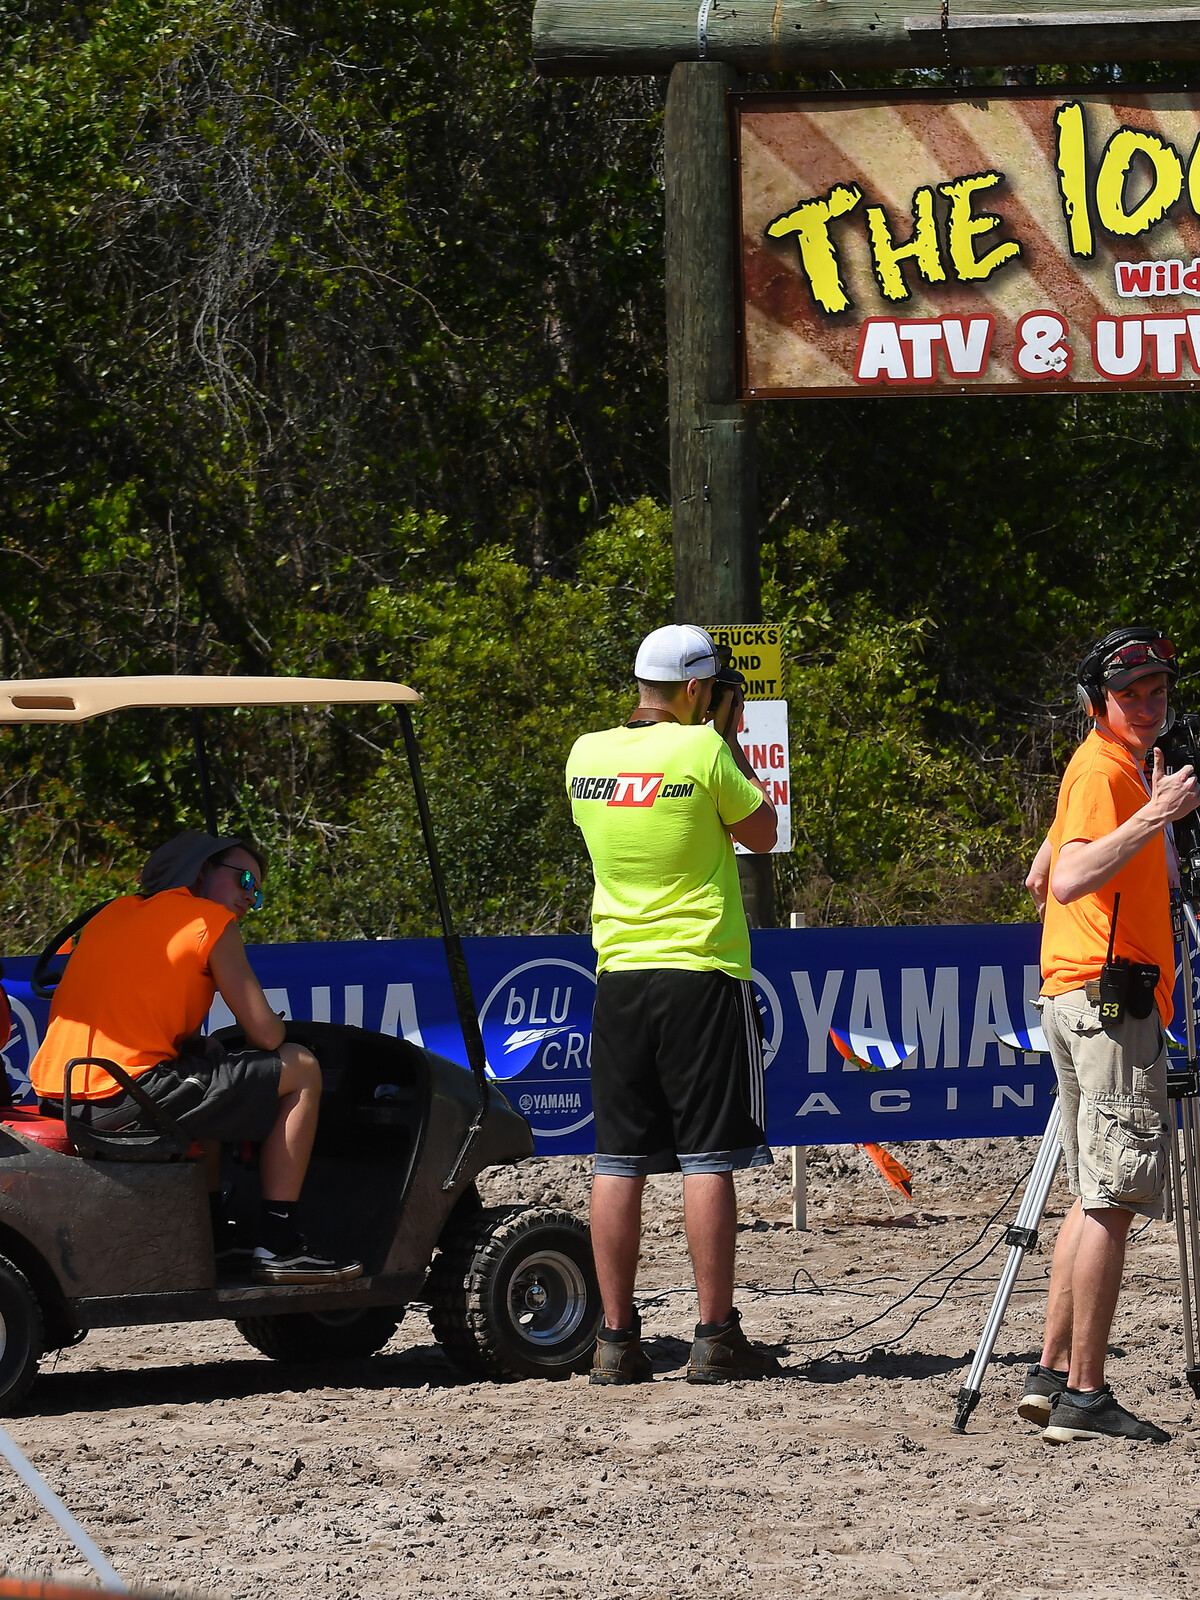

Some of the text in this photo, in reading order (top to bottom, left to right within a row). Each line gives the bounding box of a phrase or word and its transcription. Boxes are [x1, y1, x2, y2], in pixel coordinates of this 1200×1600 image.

[768, 174, 1020, 312] THE
[858, 319, 990, 379] ATV
[1018, 315, 1068, 374] &
[1102, 1003, 1119, 1018] 53
[533, 1093, 581, 1109] YAMAHA
[795, 1084, 1035, 1117] ACIN
